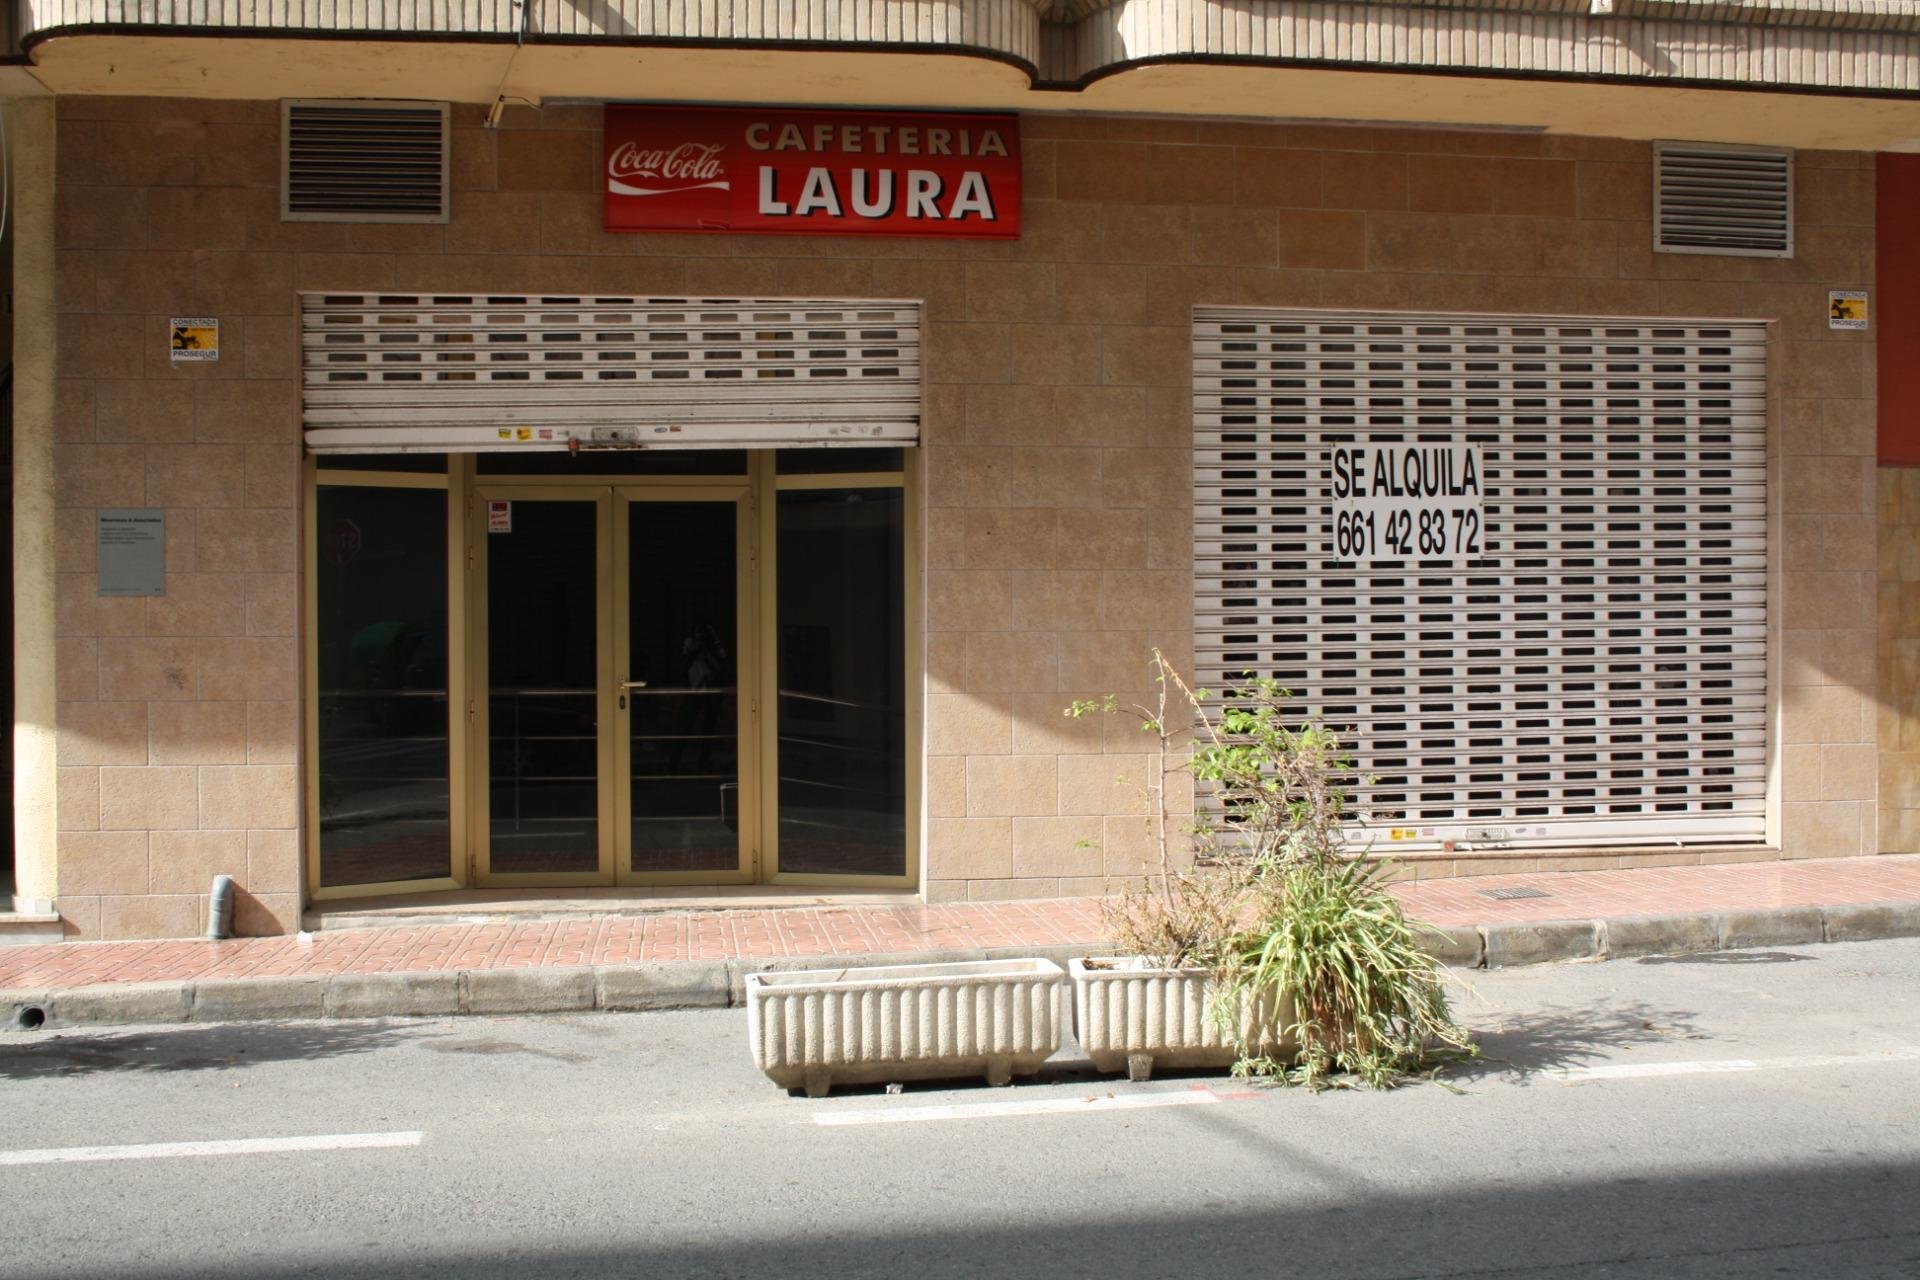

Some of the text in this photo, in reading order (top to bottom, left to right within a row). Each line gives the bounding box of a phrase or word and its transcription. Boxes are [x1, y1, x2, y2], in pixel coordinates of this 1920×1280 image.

[608, 141, 728, 178] Coca-Cola
[744, 122, 1008, 157] CAFETERIA
[758, 165, 997, 220] LAURA
[1334, 448, 1478, 498] SE ALQUILA
[1338, 508, 1479, 556] 661 42 83 72
